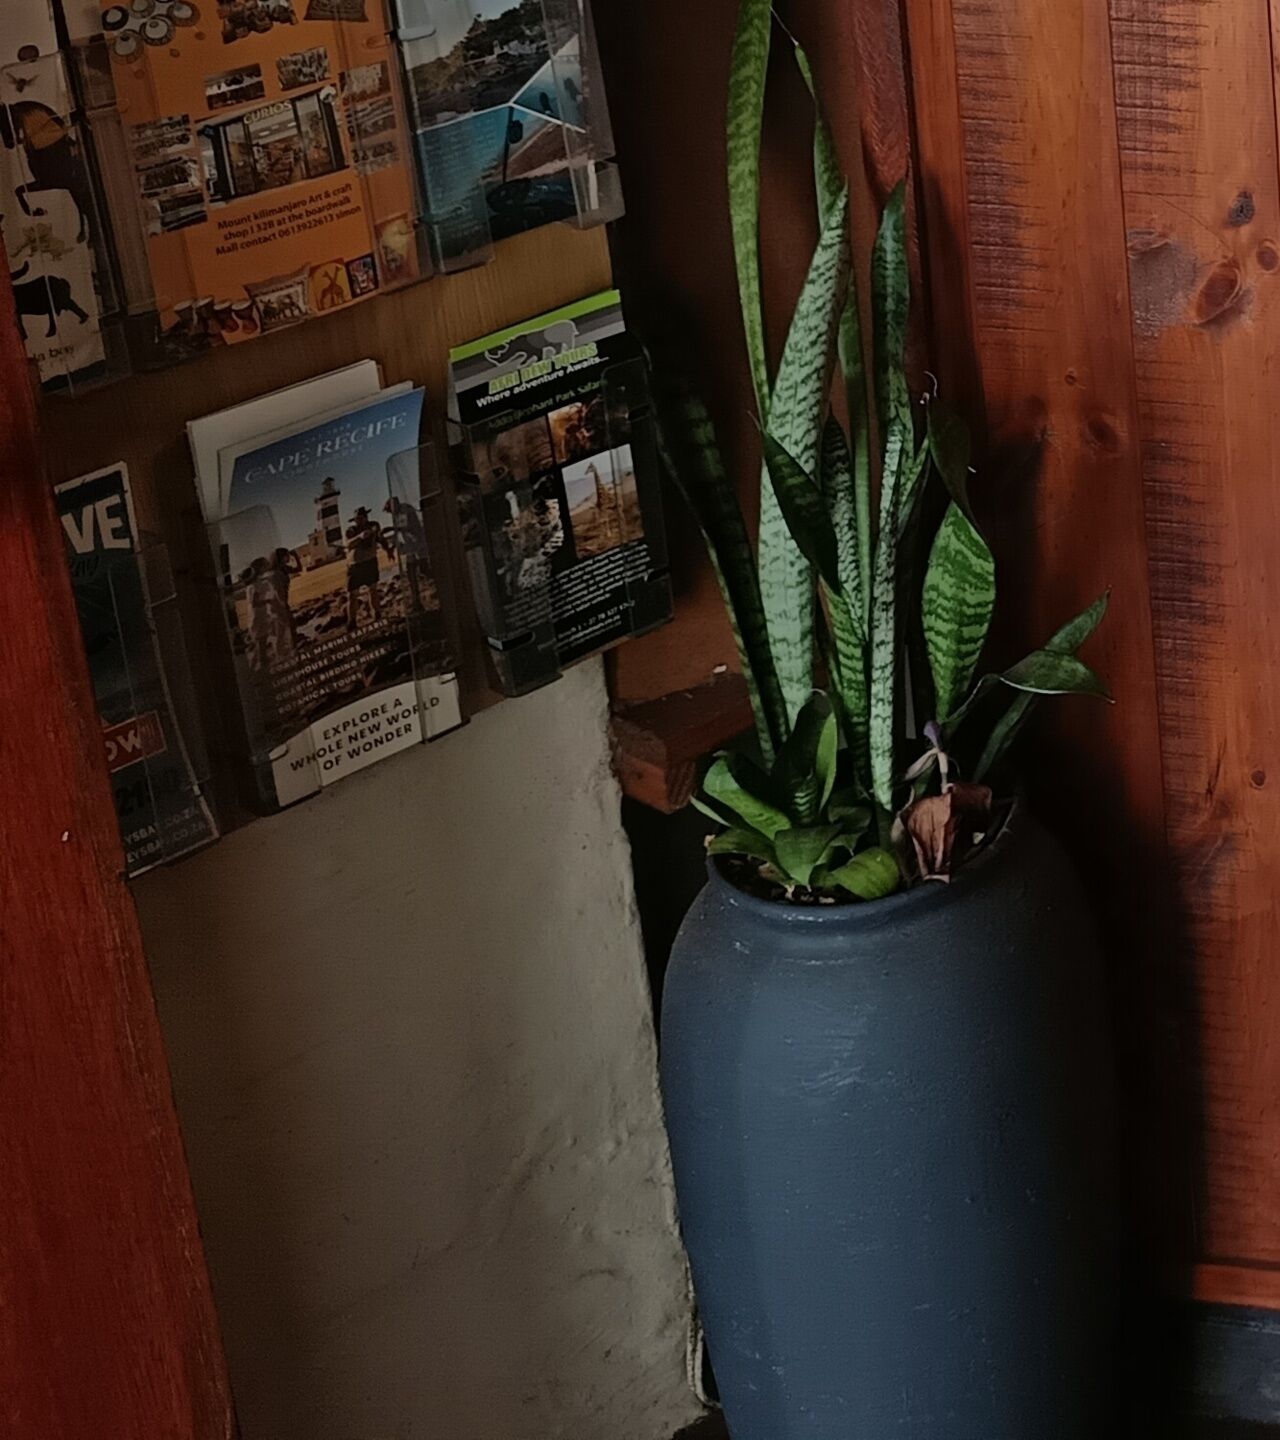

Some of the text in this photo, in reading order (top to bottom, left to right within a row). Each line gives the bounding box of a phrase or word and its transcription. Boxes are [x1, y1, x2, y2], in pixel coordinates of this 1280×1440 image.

[243, 100, 293, 125] CURIOS
[217, 182, 352, 230] Mount kilimanjaro Art & craft
[245, 412, 408, 484] CAPE RECIFE
[319, 659, 358, 682] BIRDING
[359, 646, 387, 664] HIKES
[331, 643, 362, 661] TOURS
[290, 696, 441, 773] WHOLE NEW WORLD
[323, 697, 403, 741] EXPLORE A
[322, 722, 413, 772] OF WONDER
